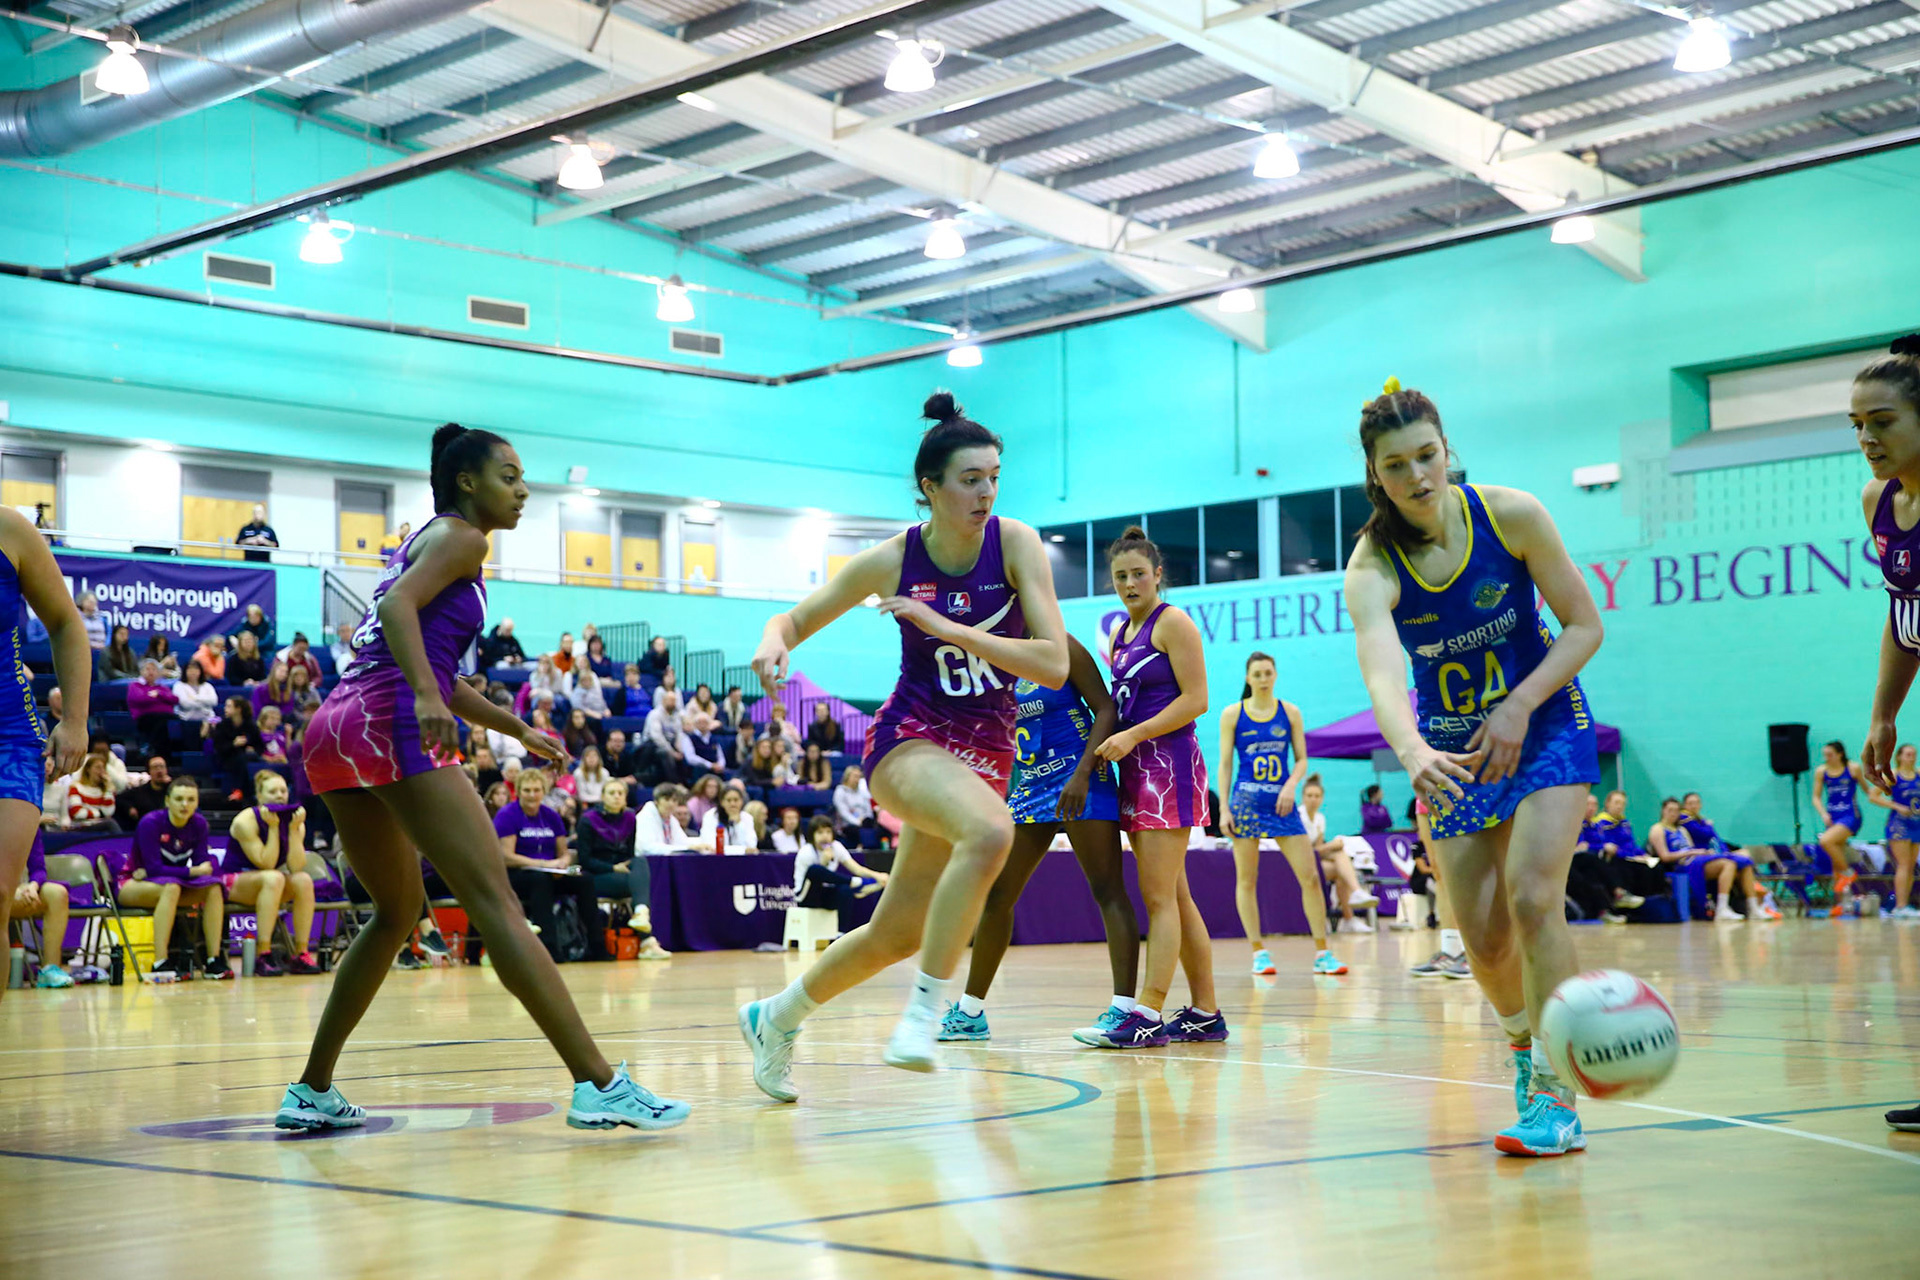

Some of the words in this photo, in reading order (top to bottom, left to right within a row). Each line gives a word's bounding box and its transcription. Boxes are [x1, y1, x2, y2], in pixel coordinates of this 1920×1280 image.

[1649, 538, 1886, 606] BEGINS
[101, 606, 192, 637] niversity
[1184, 588, 1356, 643] WHERE
[1446, 607, 1517, 650] SPORTING
[934, 645, 1004, 697] GK
[1438, 651, 1508, 715] GA
[1253, 755, 1282, 782] GD
